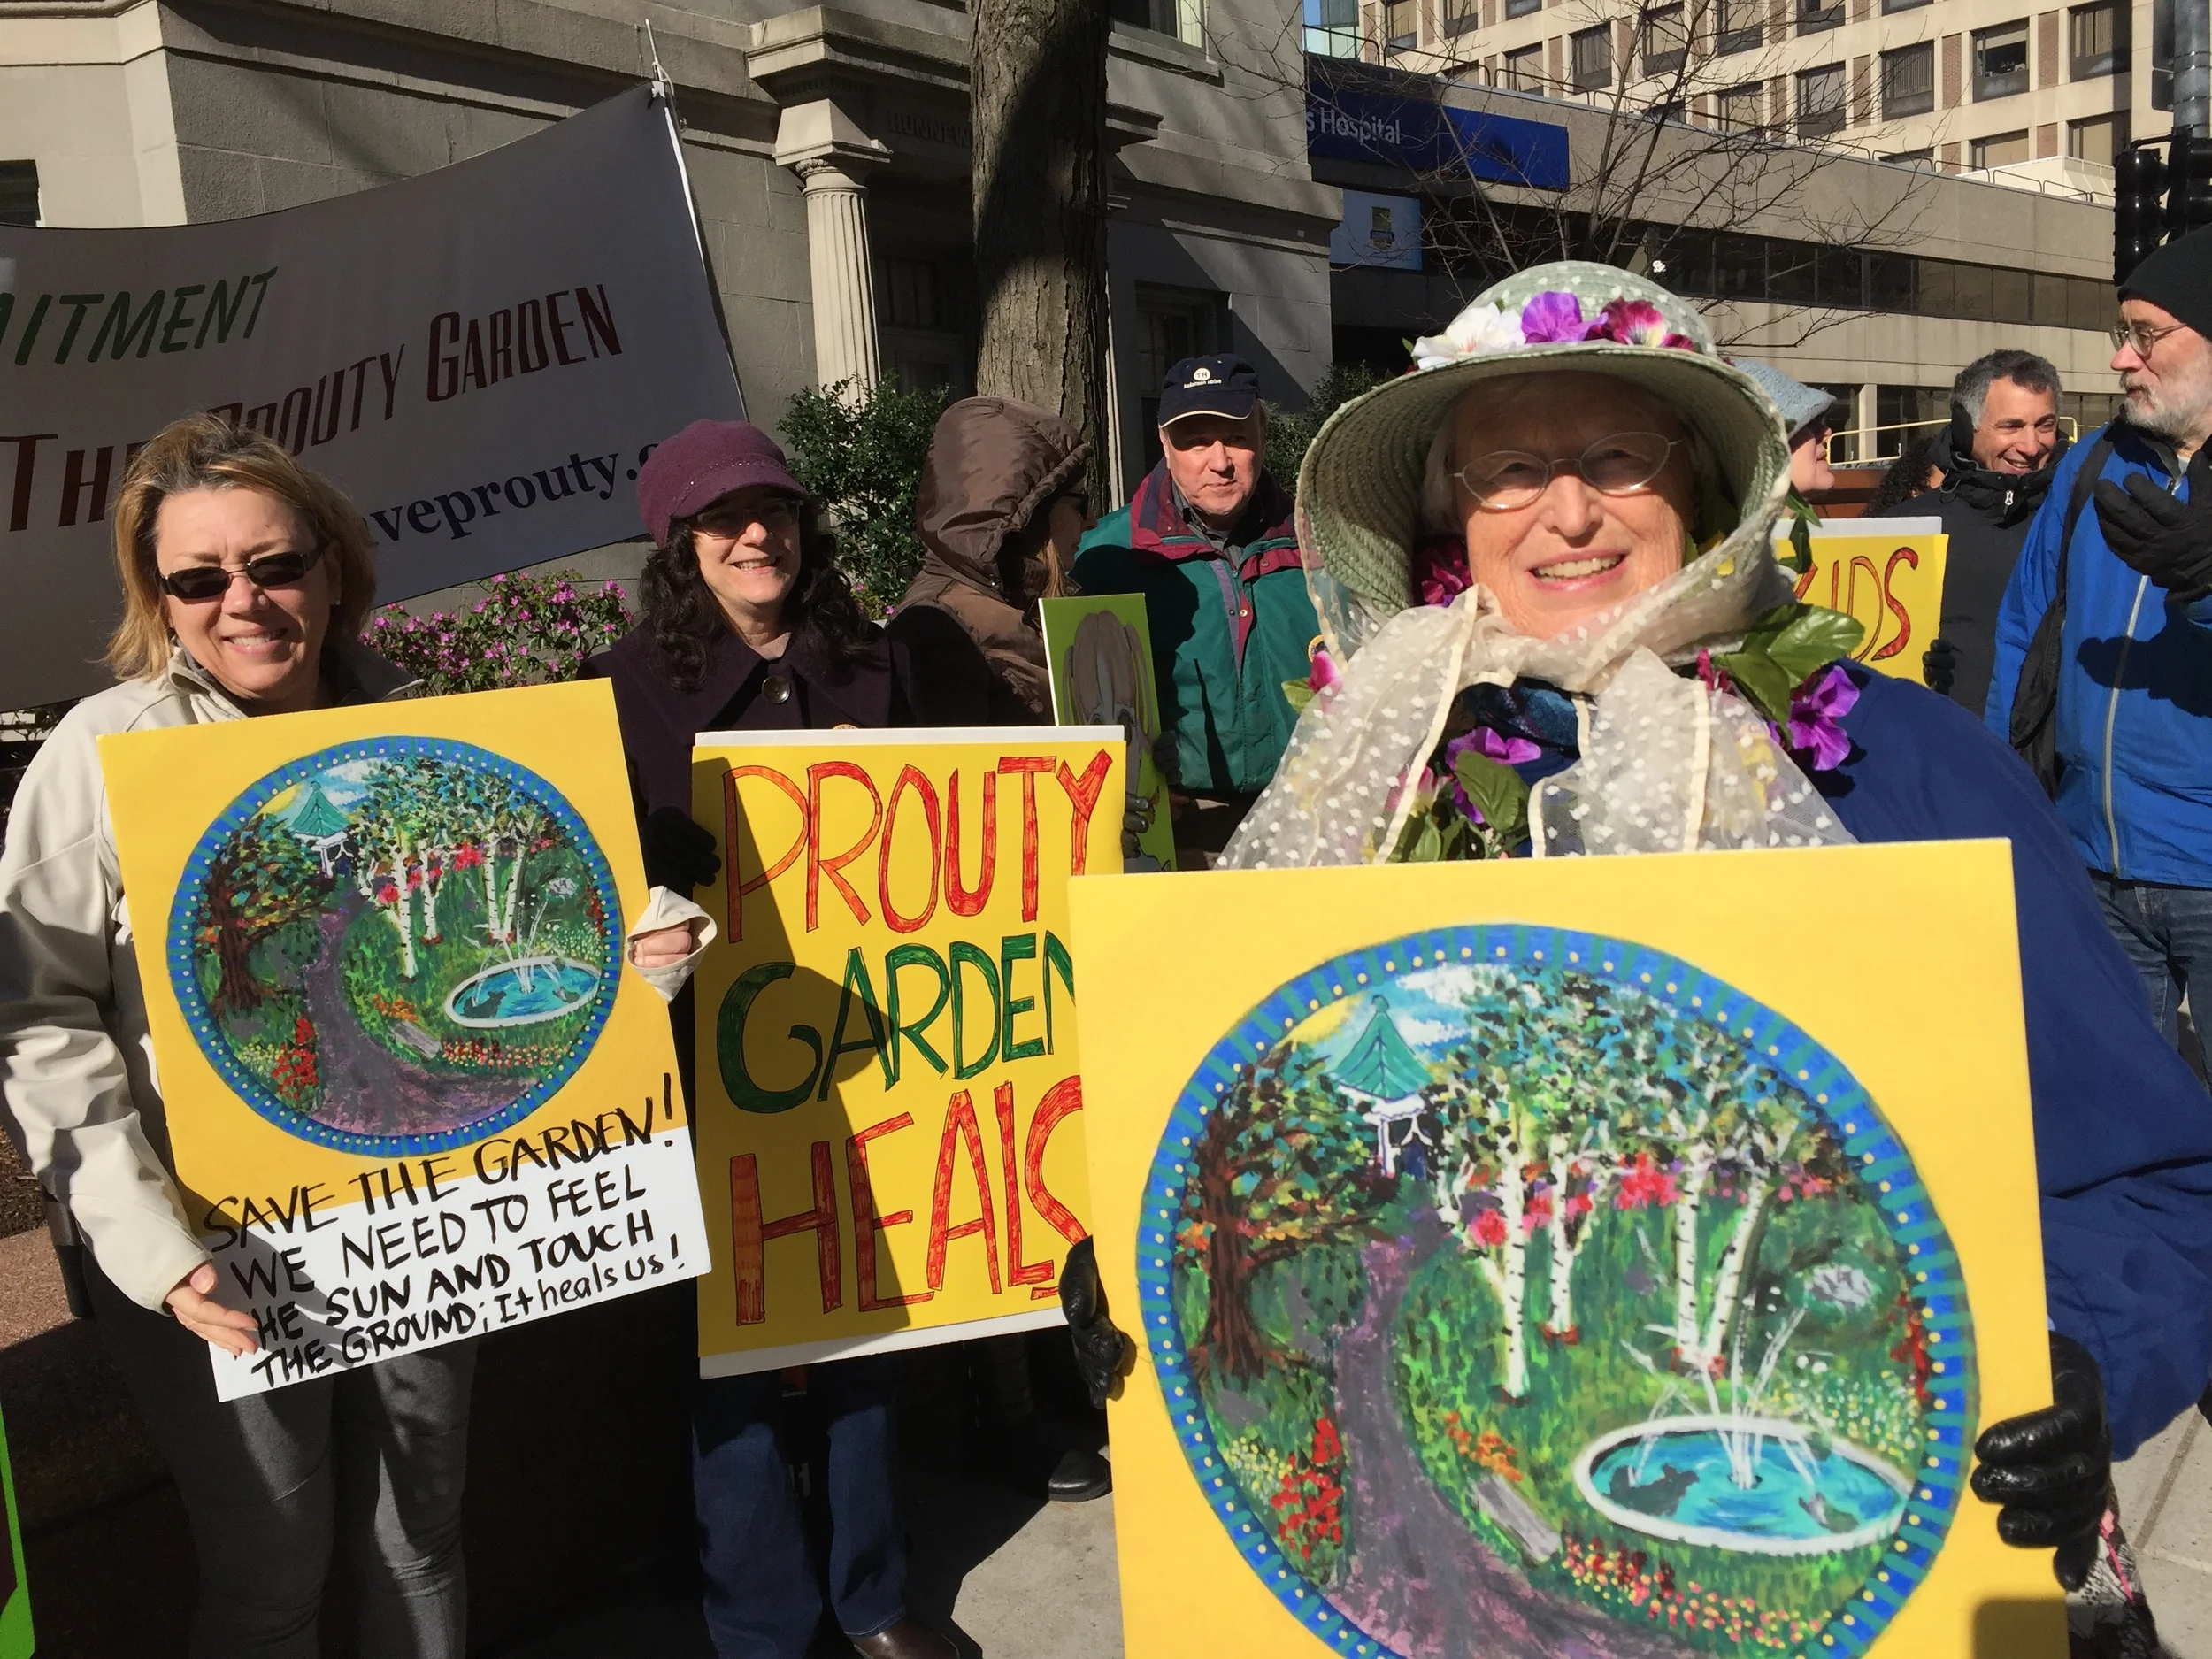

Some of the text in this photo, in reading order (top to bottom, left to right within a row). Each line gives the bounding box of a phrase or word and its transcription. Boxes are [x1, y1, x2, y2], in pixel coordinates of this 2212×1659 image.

[1319, 107, 1401, 146] Hospital
[426, 284, 623, 403] GARDEN
[362, 442, 659, 547] veprouty.
[722, 748, 1113, 944] PROUTY
[202, 1183, 335, 1253] SAVE
[348, 1154, 459, 1214] THE
[230, 1164, 647, 1300] WE NEED TO FEEL
[247, 1209, 655, 1351] HE SUN AND TOUCH
[251, 1338, 333, 1387] THE
[499, 1290, 536, 1325] It
[536, 1271, 618, 1317] heals
